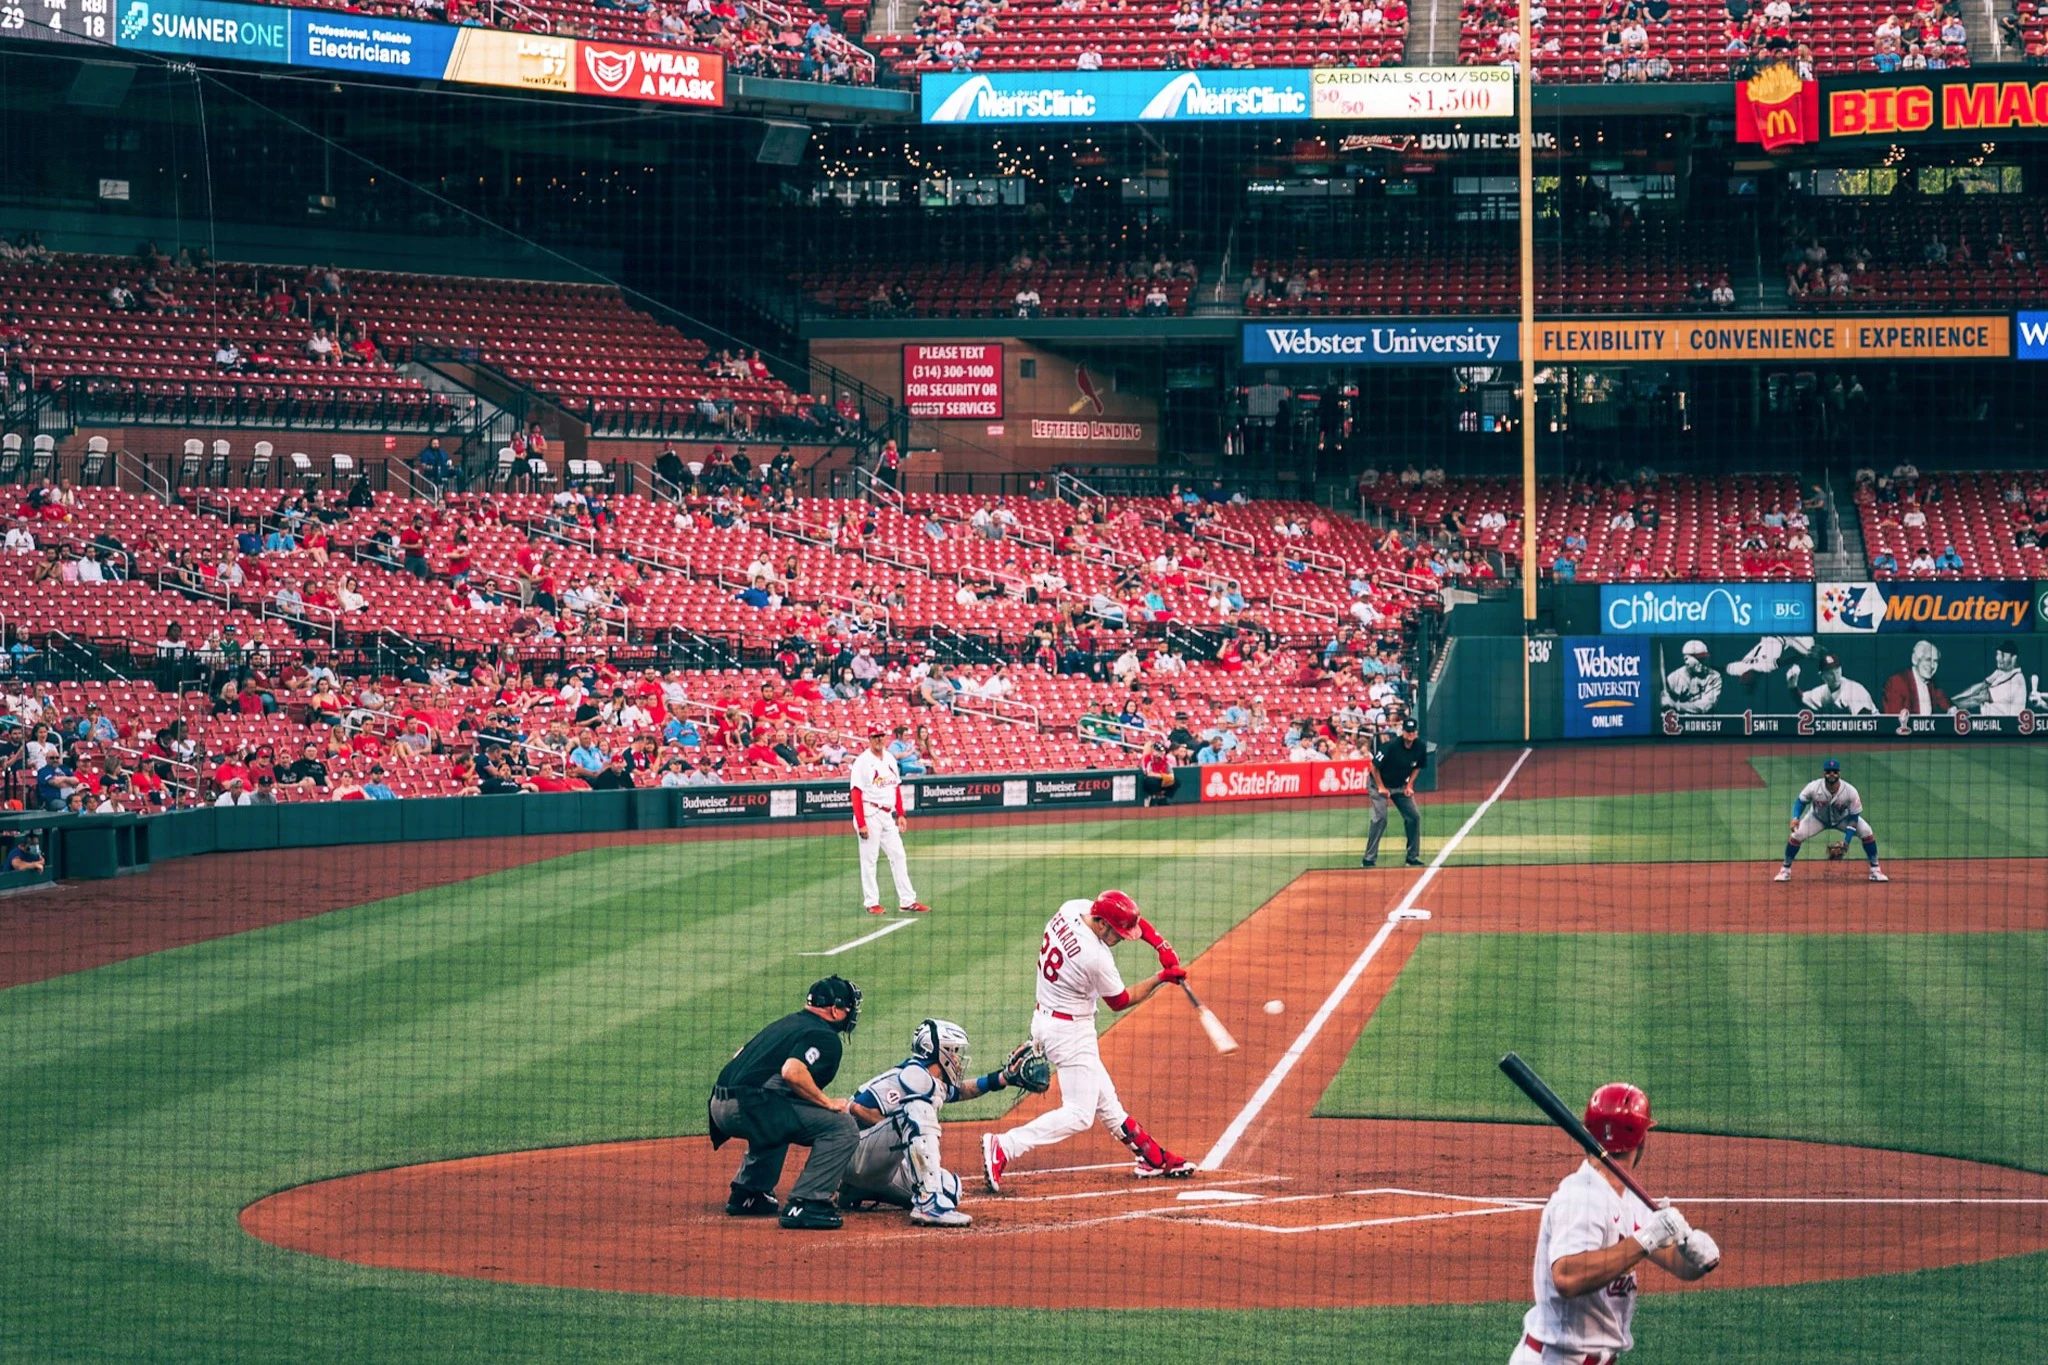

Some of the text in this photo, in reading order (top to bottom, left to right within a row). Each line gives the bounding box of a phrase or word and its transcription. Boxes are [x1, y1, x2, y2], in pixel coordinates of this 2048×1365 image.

[1, 6, 105, 37] 29 4 18
[307, 22, 371, 41] Professional,
[308, 36, 411, 65] Electricians
[640, 51, 699, 77] WEAR
[1314, 71, 1511, 85] CARDINALS.COM/5050
[640, 75, 715, 101] A MASK
[1408, 88, 1491, 114] $1,500
[1829, 86, 1933, 137] BIG
[1266, 327, 1501, 359] Webster University
[1543, 325, 1989, 352] FLEXIBILITY CONVENIENCE EXPERIENCE
[919, 346, 985, 360] PLEASE TEXT
[912, 365, 994, 380] (314) 300-1000
[907, 383, 998, 396] FOR SECURITY OR
[911, 401, 996, 415] GUEST SERVICES
[1775, 602, 1801, 617] BJC
[1884, 594, 2029, 627] MOLottery
[1573, 646, 1640, 678] Webster
[1577, 681, 1640, 700] UNIVERSITY
[1591, 714, 1624, 728] ONLINE
[1684, 720, 1722, 732] HORNSBY
[1743, 708, 1779, 735] 1 SMITH
[1797, 709, 1879, 735] 2 SCHOENDIENST
[1913, 719, 1936, 732] BUCK
[1953, 709, 2002, 735] 6 MUSIAL
[2017, 708, 2035, 735] 9
[922, 782, 1001, 798] Budweiser ZERO
[1035, 779, 1111, 793] Budweiser ZERO
[682, 793, 768, 809] Budweiser ZERO
[805, 790, 850, 803] Budweiser
